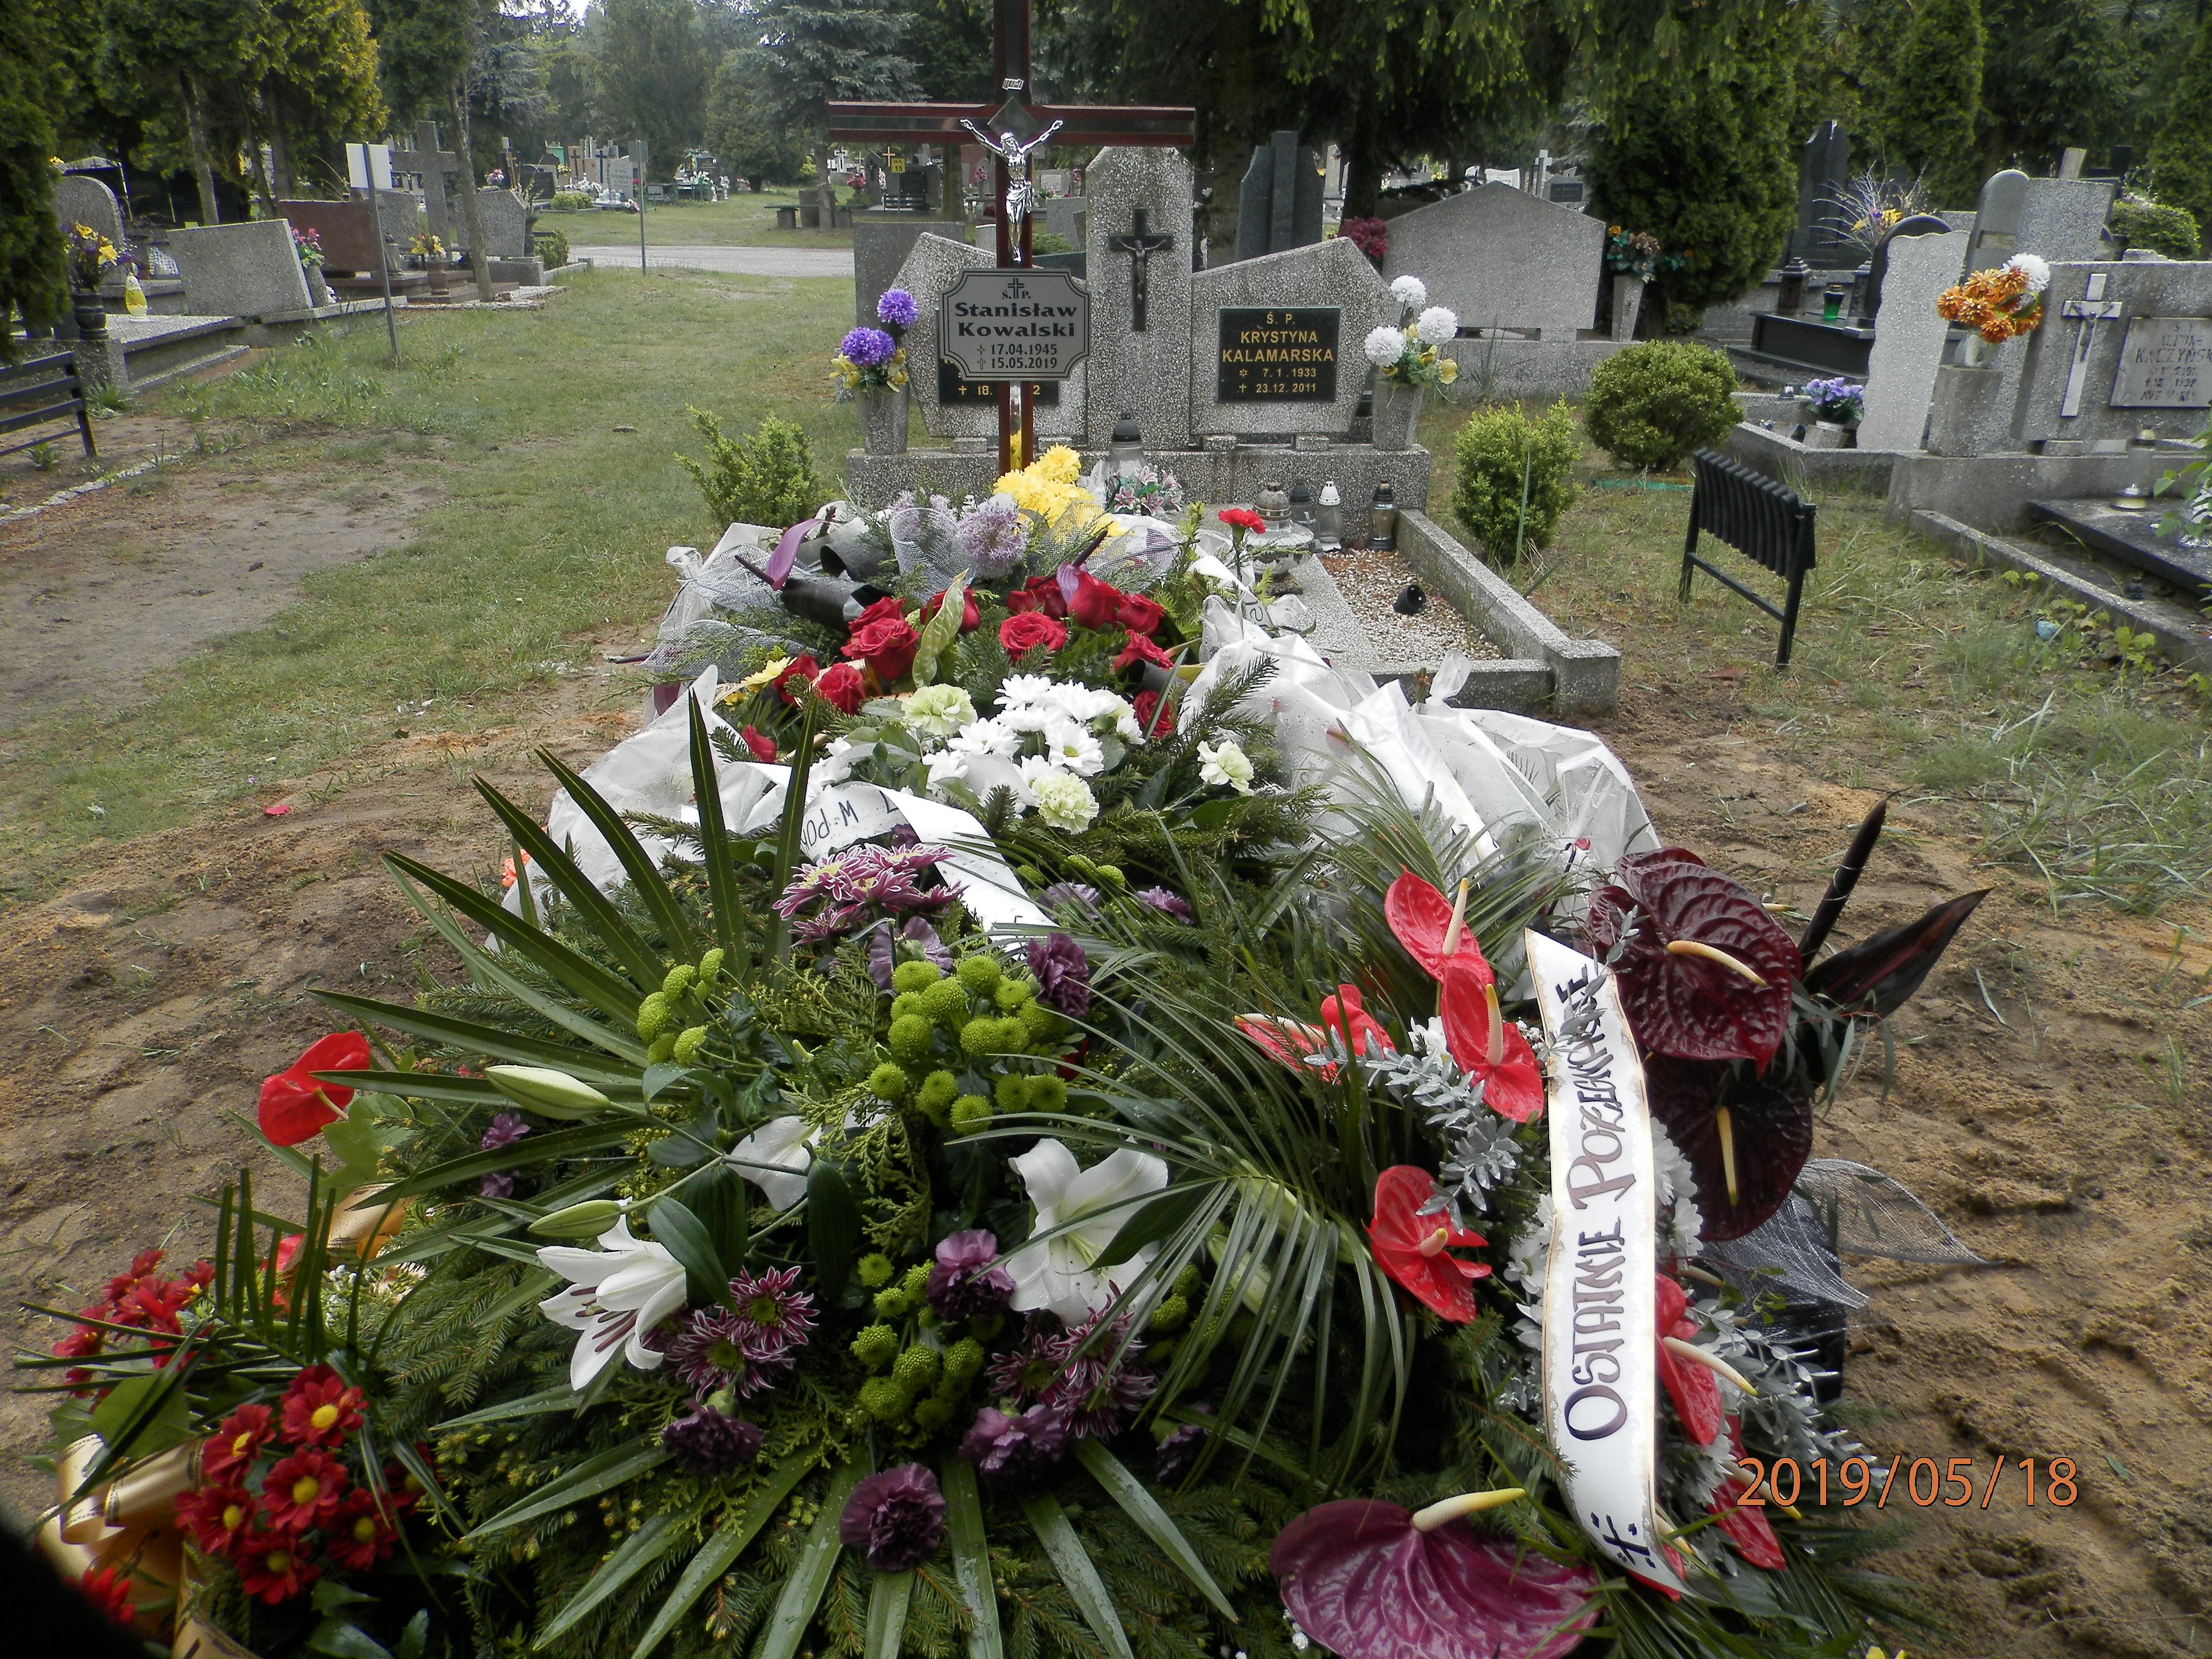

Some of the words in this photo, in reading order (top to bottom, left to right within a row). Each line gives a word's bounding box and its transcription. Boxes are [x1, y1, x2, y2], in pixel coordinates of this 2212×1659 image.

[954, 302, 1077, 317] Stanisław
[958, 322, 1075, 337] Kowalski
[1240, 330, 1317, 344] KRYSTYNA
[991, 344, 1058, 355] 17.04.1945
[1222, 349, 1334, 362] KALAMARSKA
[991, 357, 1058, 369] 15.05.2019
[1563, 1216, 1628, 1441] OSTATNIE
